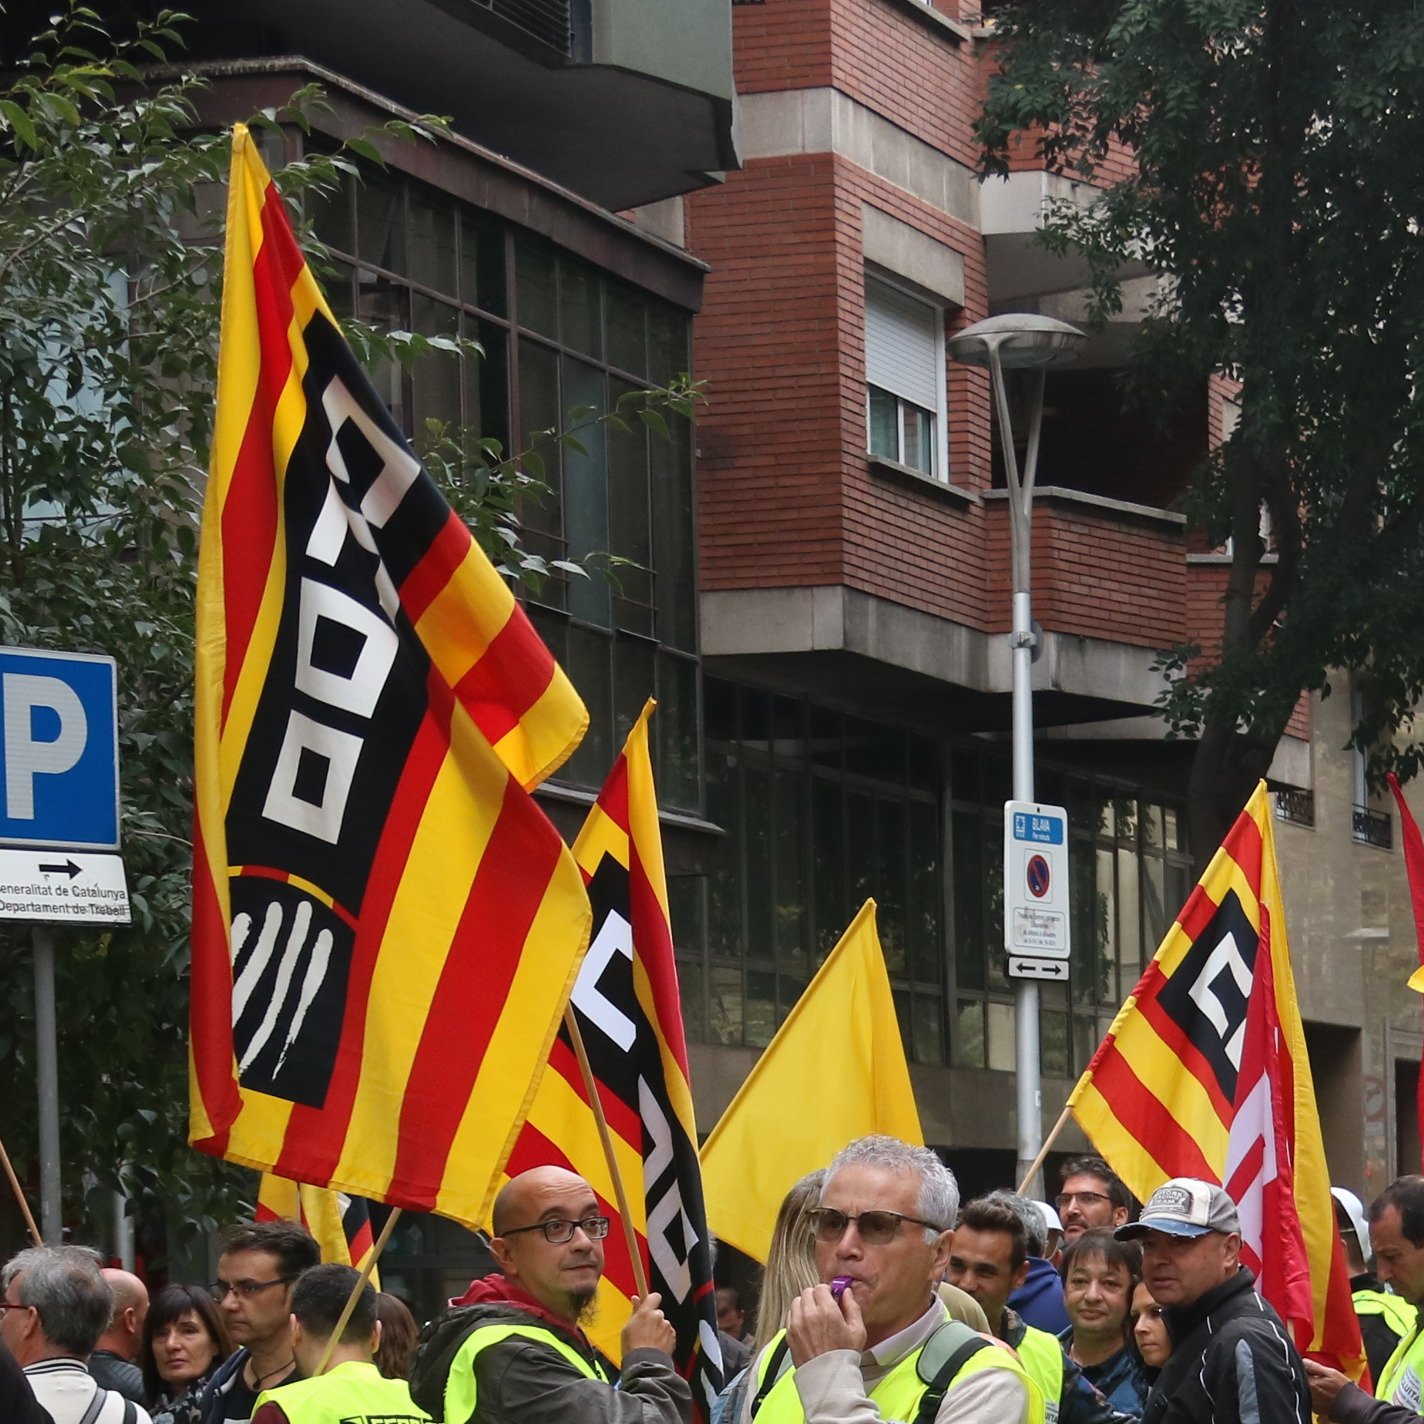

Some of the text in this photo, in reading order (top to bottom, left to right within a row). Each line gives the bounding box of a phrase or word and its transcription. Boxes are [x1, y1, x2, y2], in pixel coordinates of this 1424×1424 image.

[3, 672, 88, 820] P
[56, 885, 69, 897] de
[72, 903, 86, 914] de
